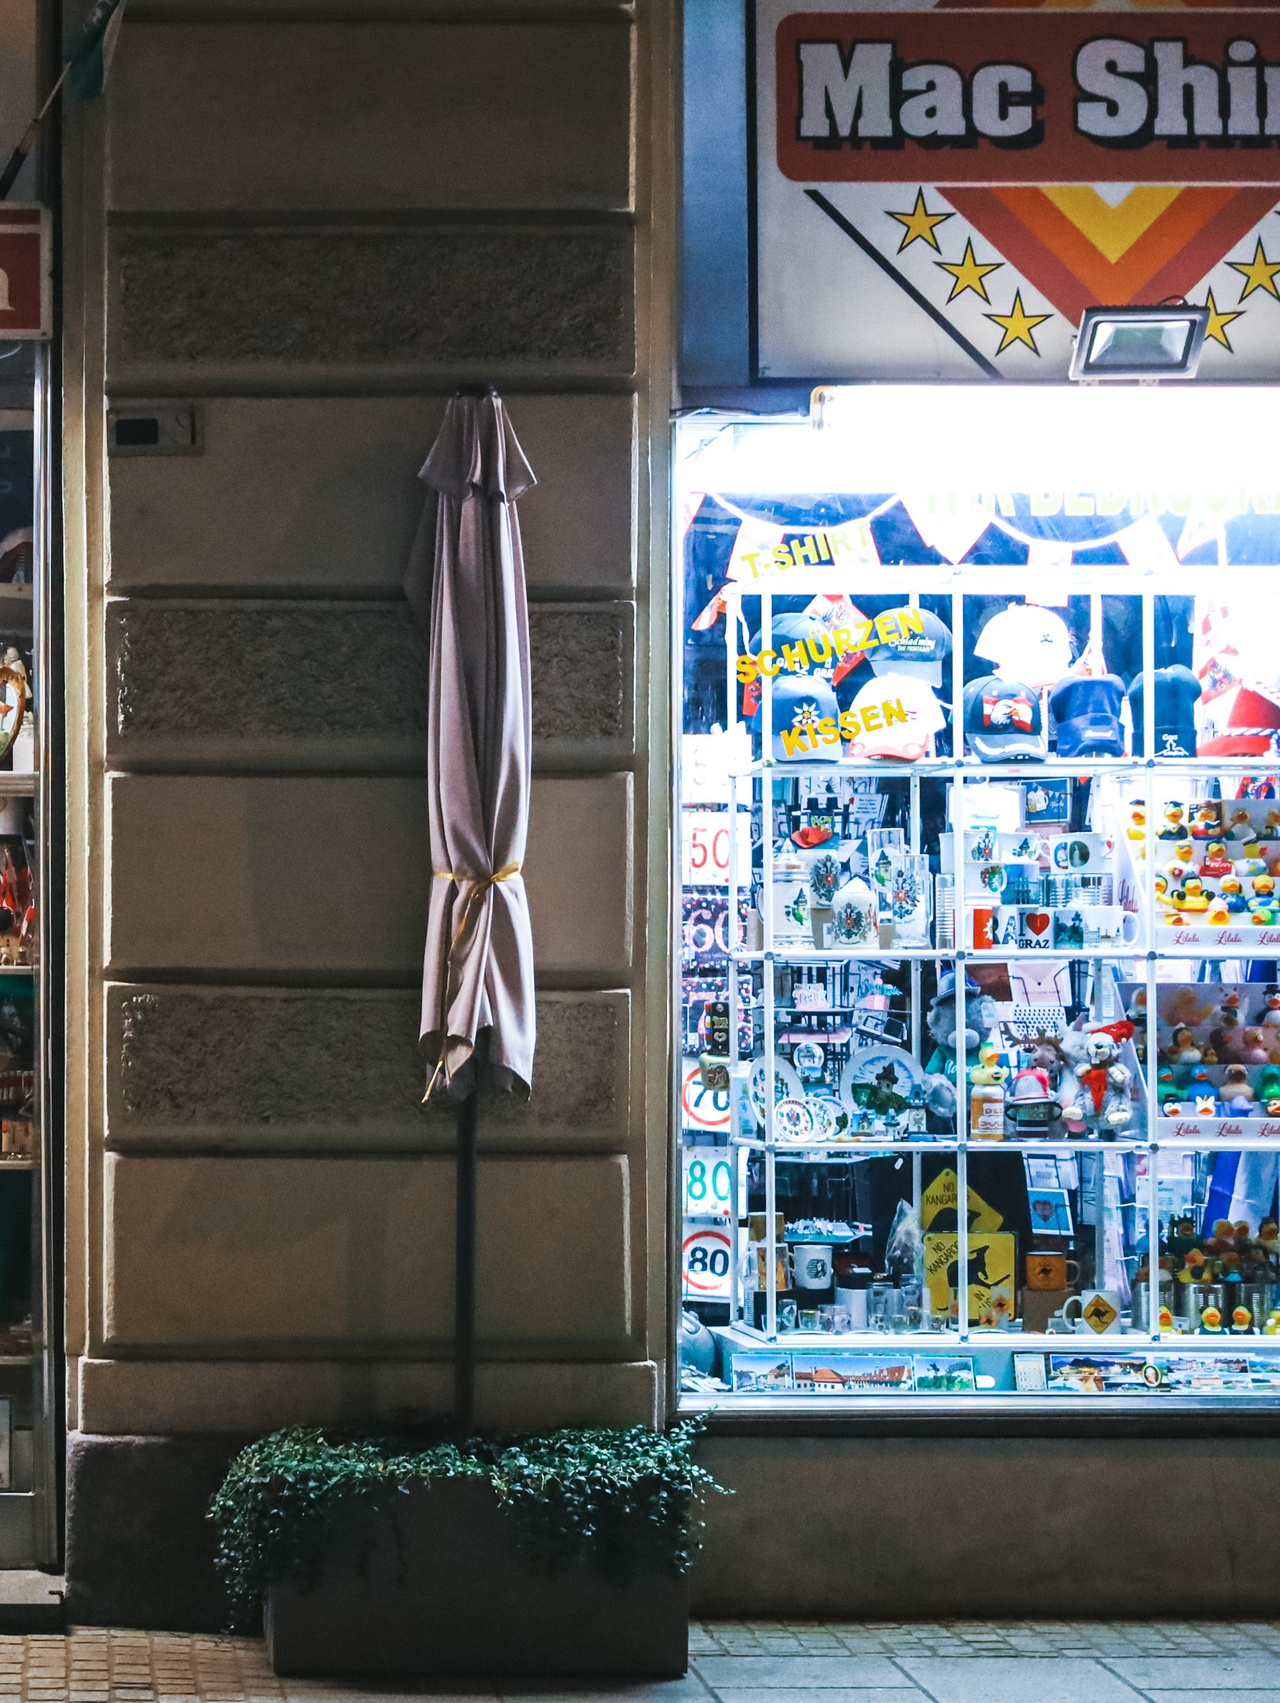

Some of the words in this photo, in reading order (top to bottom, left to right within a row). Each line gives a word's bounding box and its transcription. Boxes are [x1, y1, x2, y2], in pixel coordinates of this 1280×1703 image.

[796, 36, 1045, 150] Mac
[740, 524, 873, 579] T-SHIRT
[736, 609, 926, 684] SCHÜRZEN
[779, 698, 908, 757] KISSEN
[691, 827, 730, 869] 50
[1018, 939, 1050, 949] GRAZ
[1172, 930, 1201, 946] Lilalu
[1214, 930, 1243, 946] Lilalu
[1172, 1122, 1201, 1137] Lilalu
[1215, 1122, 1243, 1137] Lilalu
[688, 1160, 731, 1201] 80
[943, 1182, 955, 1193] NO
[688, 1246, 730, 1277] 80
[932, 1241, 946, 1254] NO
